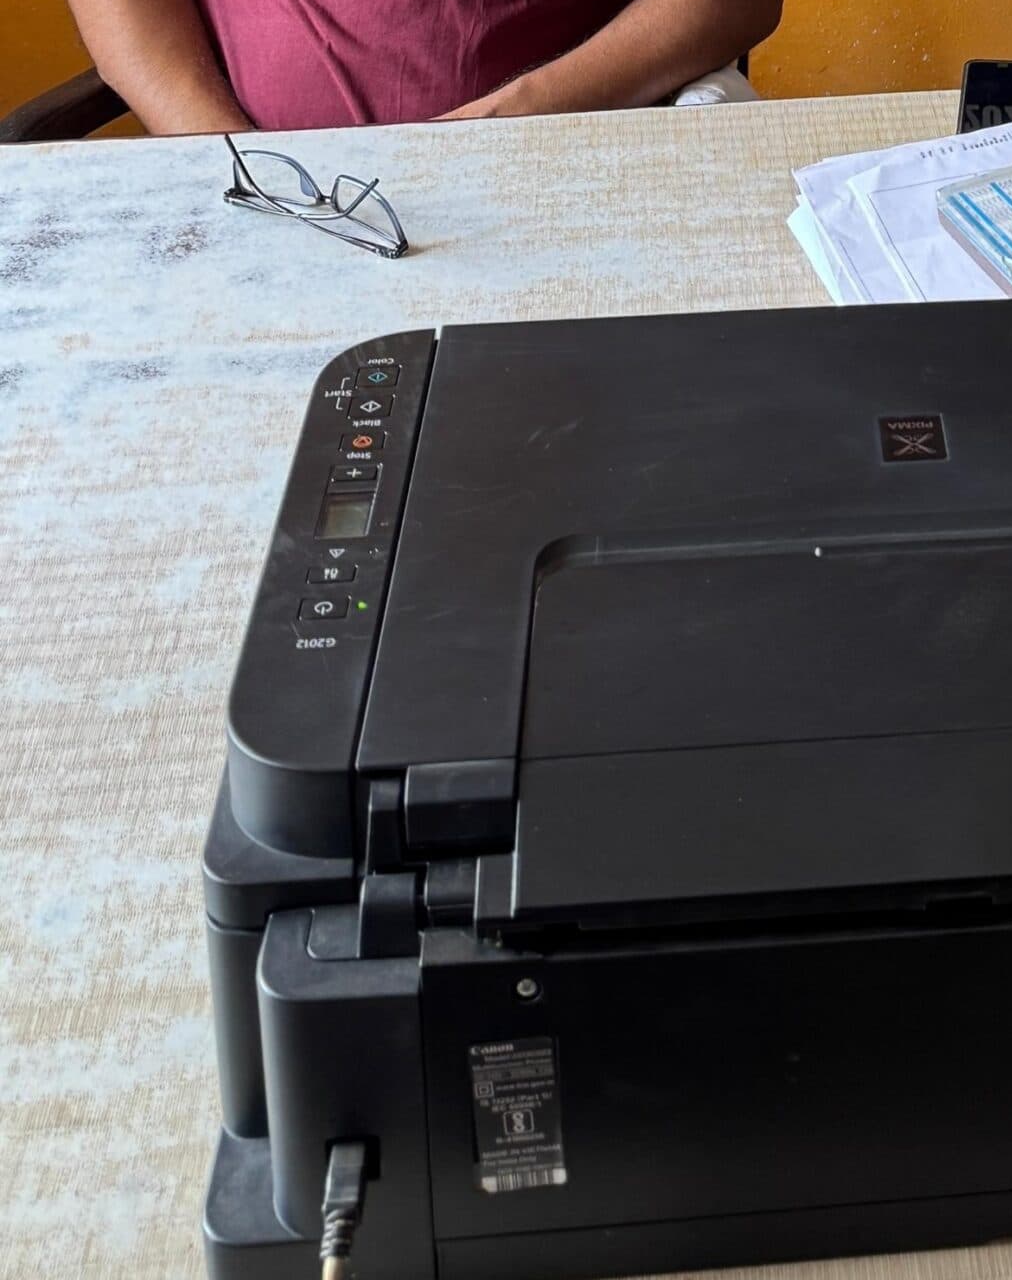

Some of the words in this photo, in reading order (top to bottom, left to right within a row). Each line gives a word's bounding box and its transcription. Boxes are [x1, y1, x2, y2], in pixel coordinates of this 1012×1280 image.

[367, 357, 395, 365] Color
[324, 389, 353, 397] Start
[352, 419, 382, 428] Black
[888, 421, 933, 430] PIXMA
[346, 451, 372, 460] Stop
[296, 637, 337, 649] G2012
[470, 1043, 514, 1056] Canon
